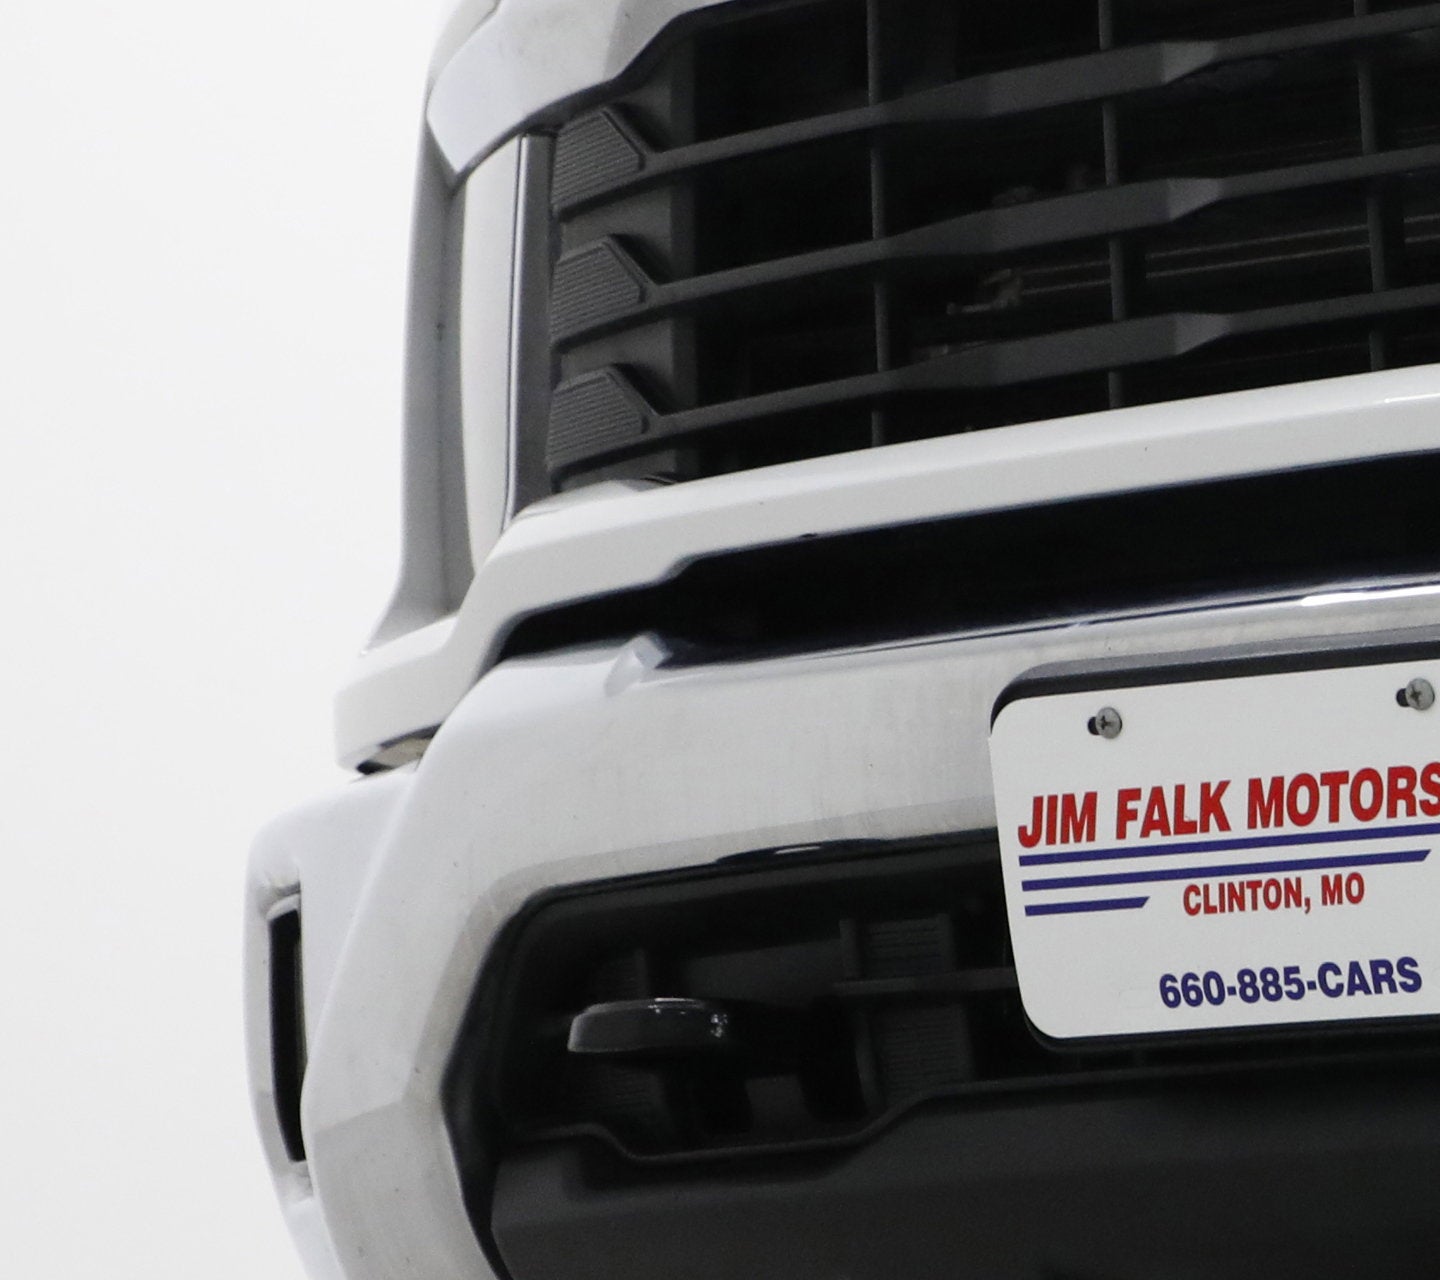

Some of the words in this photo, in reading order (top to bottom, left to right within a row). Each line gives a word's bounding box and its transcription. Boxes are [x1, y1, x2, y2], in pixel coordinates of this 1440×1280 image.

[1017, 791, 1098, 848] JIM
[1116, 780, 1231, 840] FALK
[1183, 877, 1312, 916] CLINTON,
[1321, 872, 1365, 905] MO
[1159, 956, 1422, 1008] 660-885-CARS
